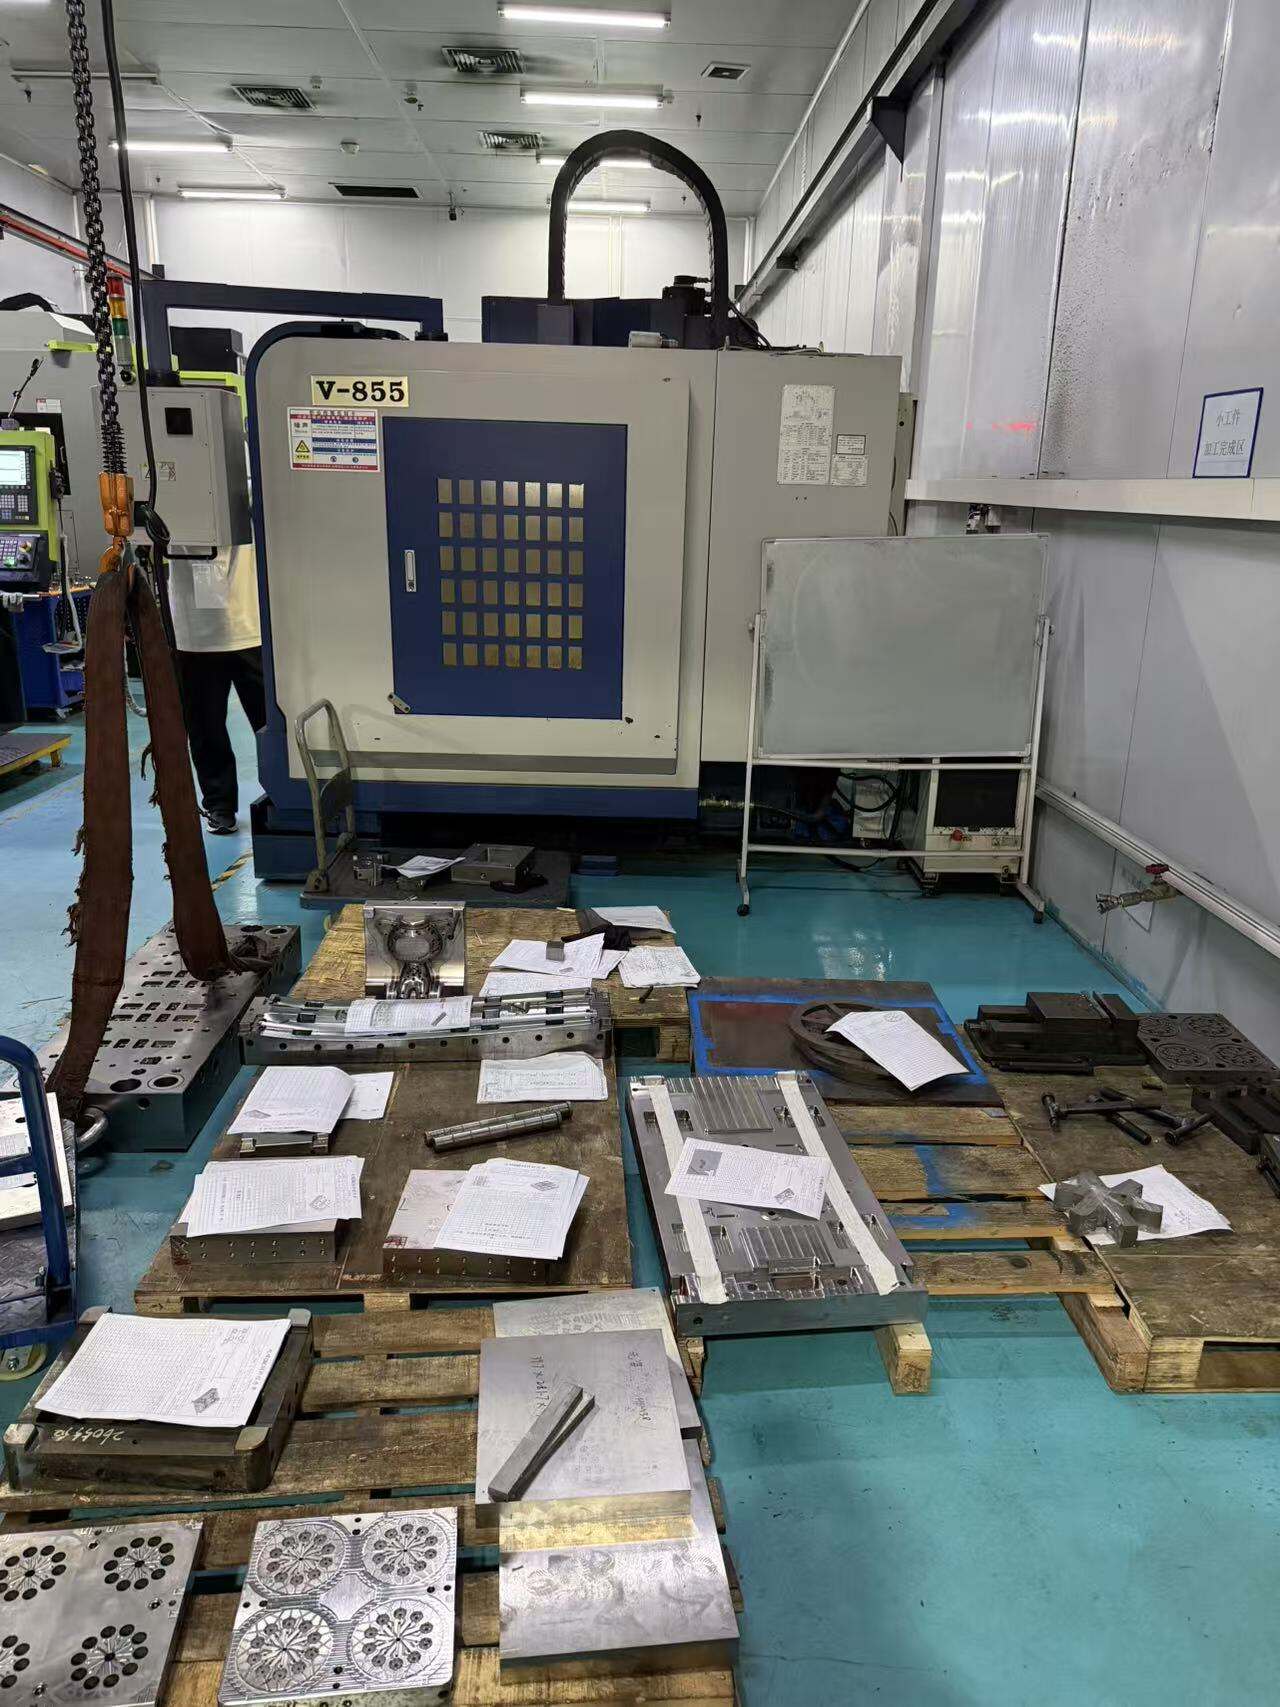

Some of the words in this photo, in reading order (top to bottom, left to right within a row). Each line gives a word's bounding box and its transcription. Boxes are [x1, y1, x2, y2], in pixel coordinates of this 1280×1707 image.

[316, 381, 404, 402] V-855
[1204, 439, 1245, 456] 加工完成区
